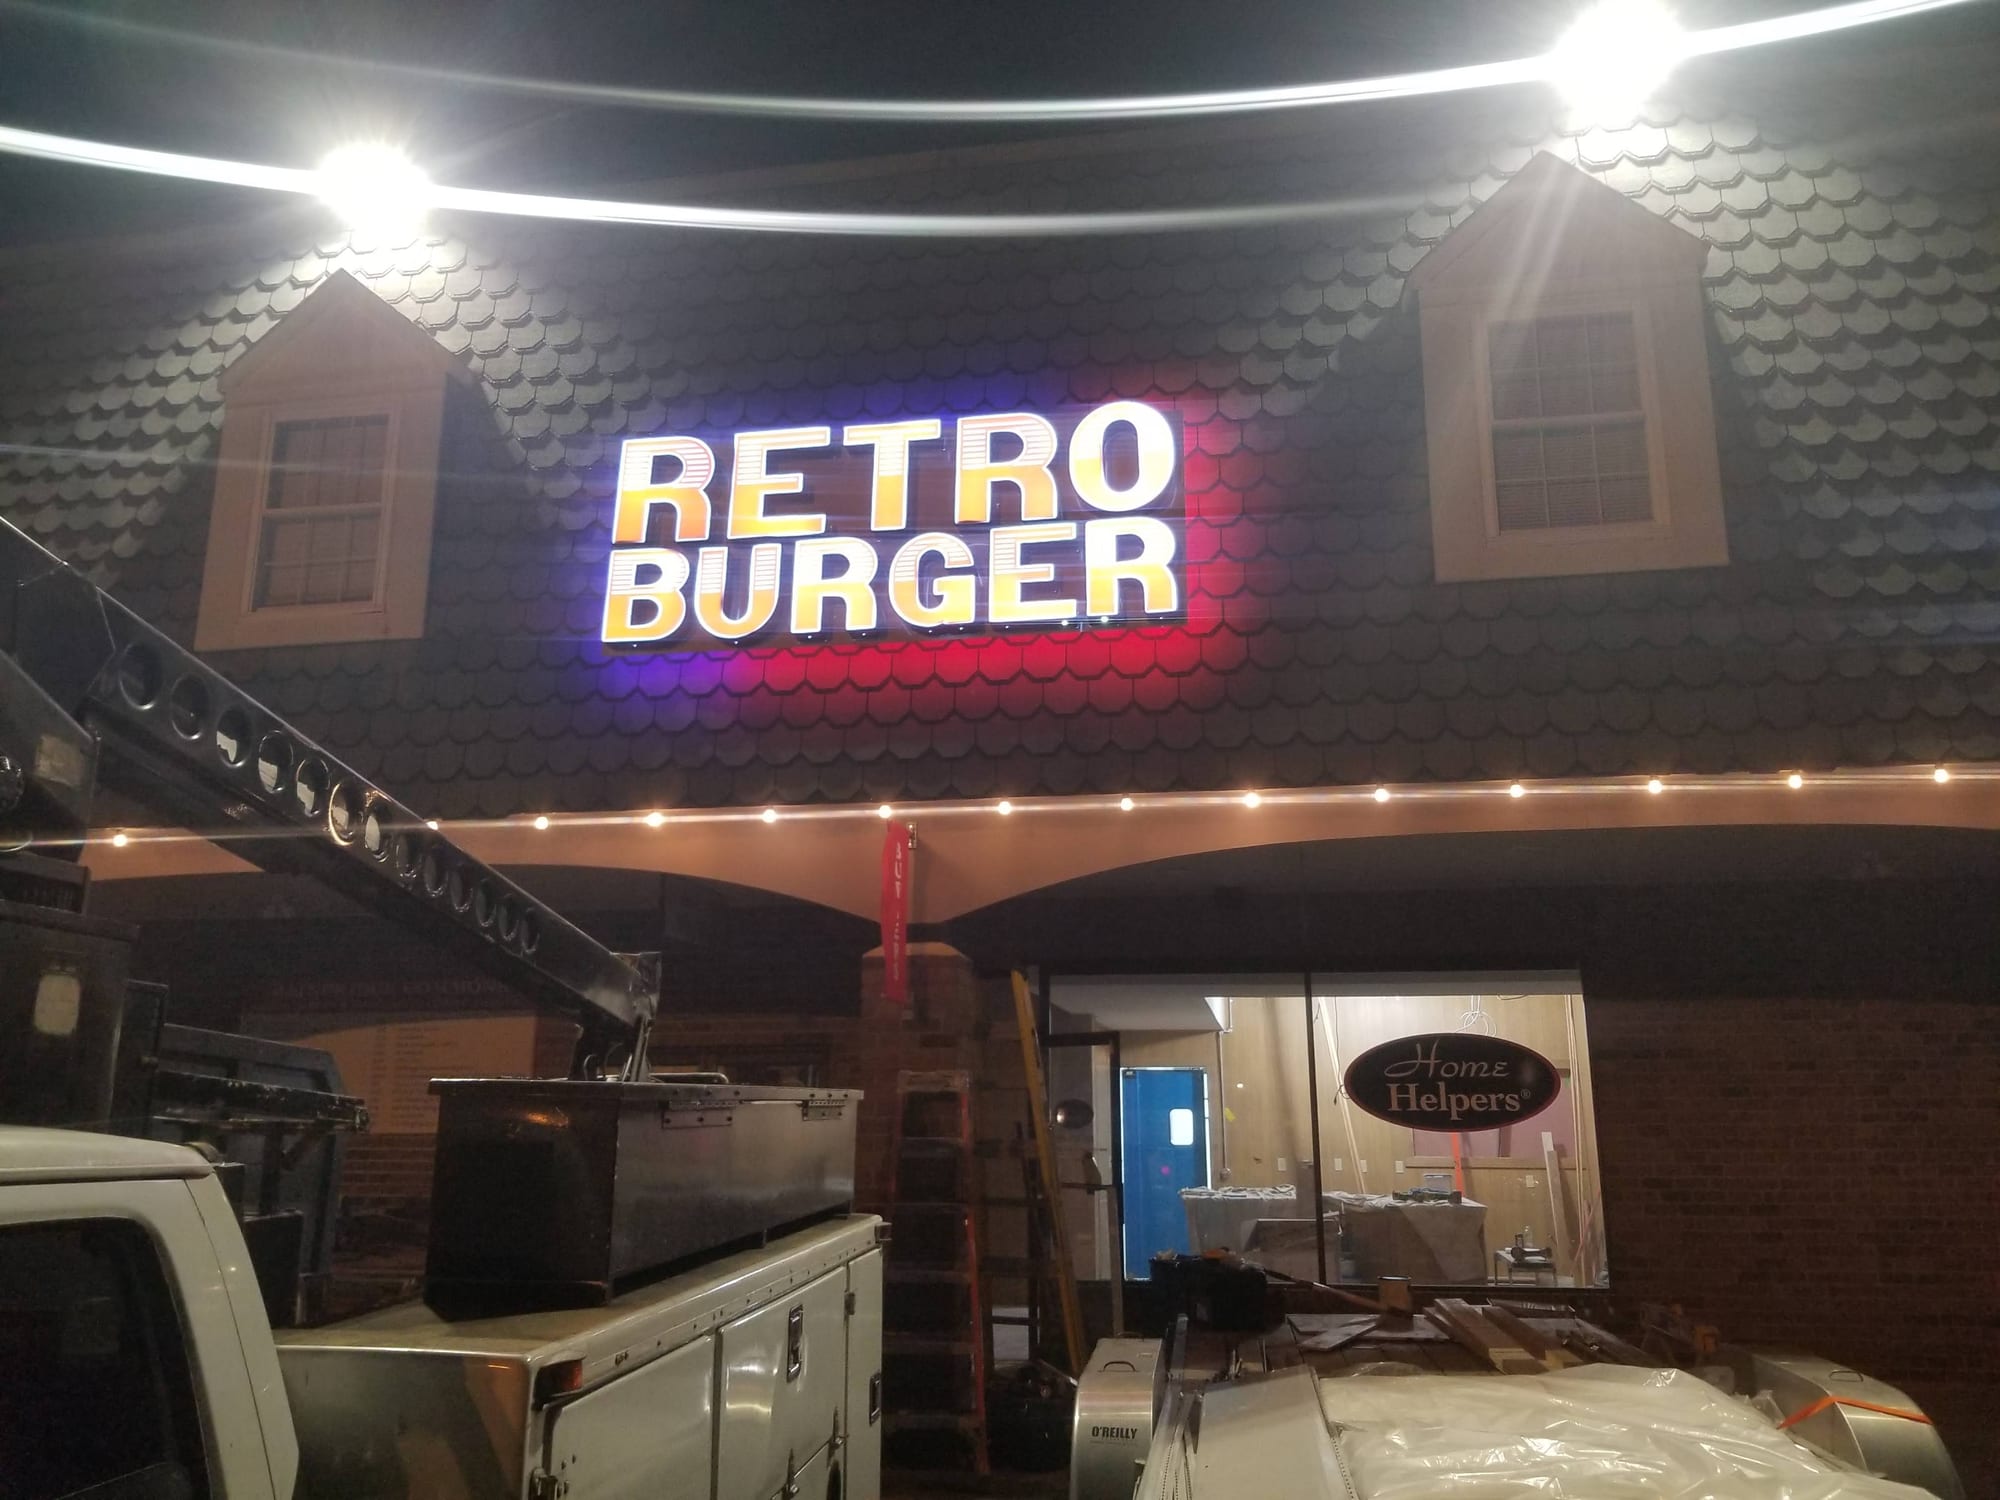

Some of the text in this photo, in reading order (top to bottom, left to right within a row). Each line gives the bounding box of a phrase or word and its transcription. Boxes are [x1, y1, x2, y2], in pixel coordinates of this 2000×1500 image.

[612, 401, 1176, 544] RETRO
[601, 517, 1179, 643] BURGER
[1384, 1039, 1511, 1079] Home
[1091, 1425, 1138, 1440] O'REILLY
